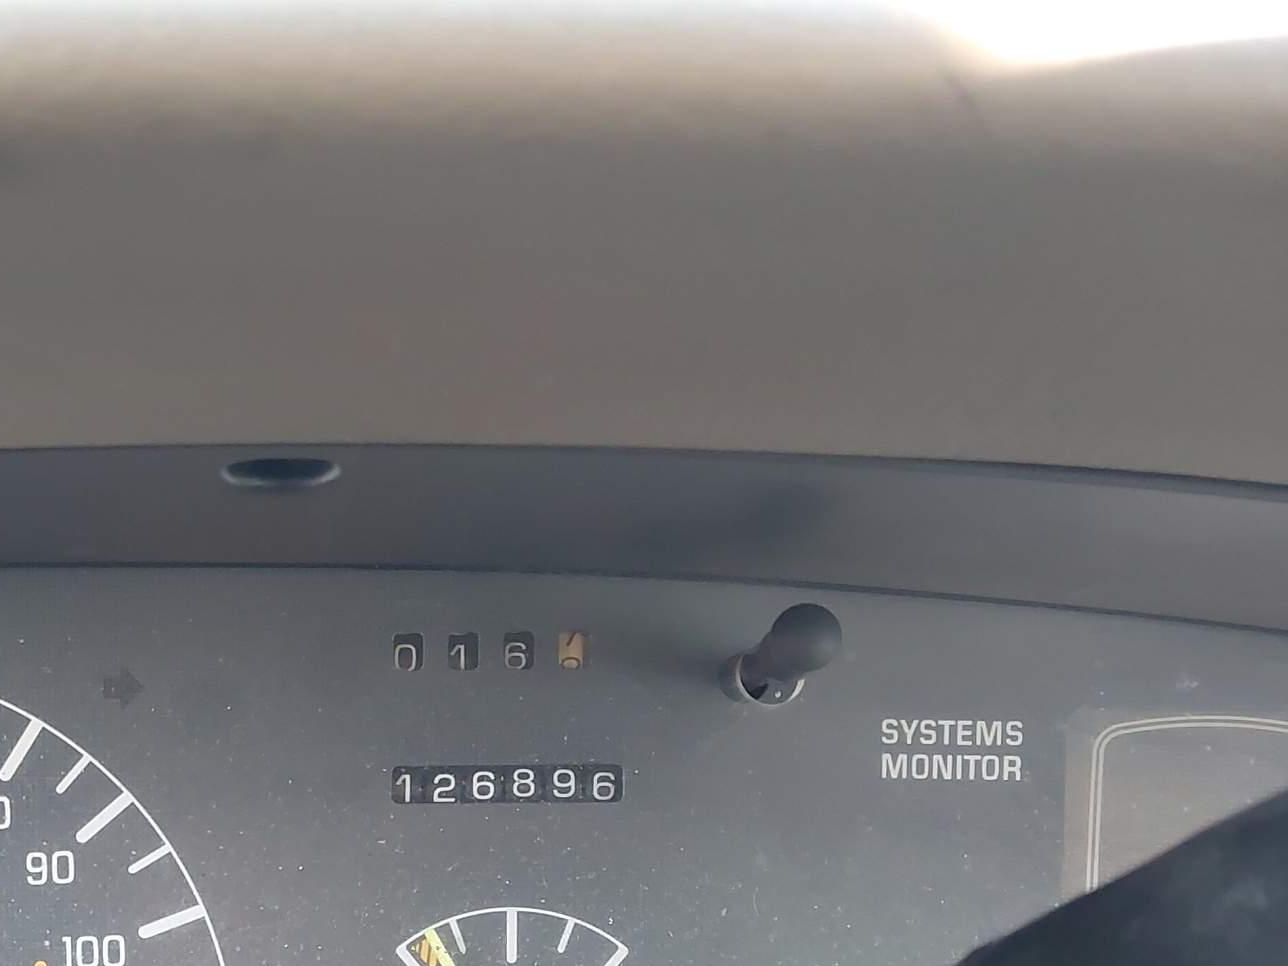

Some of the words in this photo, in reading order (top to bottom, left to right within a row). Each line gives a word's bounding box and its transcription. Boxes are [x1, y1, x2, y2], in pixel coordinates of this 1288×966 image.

[882, 719, 1022, 745] SYSTEMS
[882, 754, 1021, 780] MONITOR
[395, 768, 616, 803] 126896
[27, 851, 74, 884] 90
